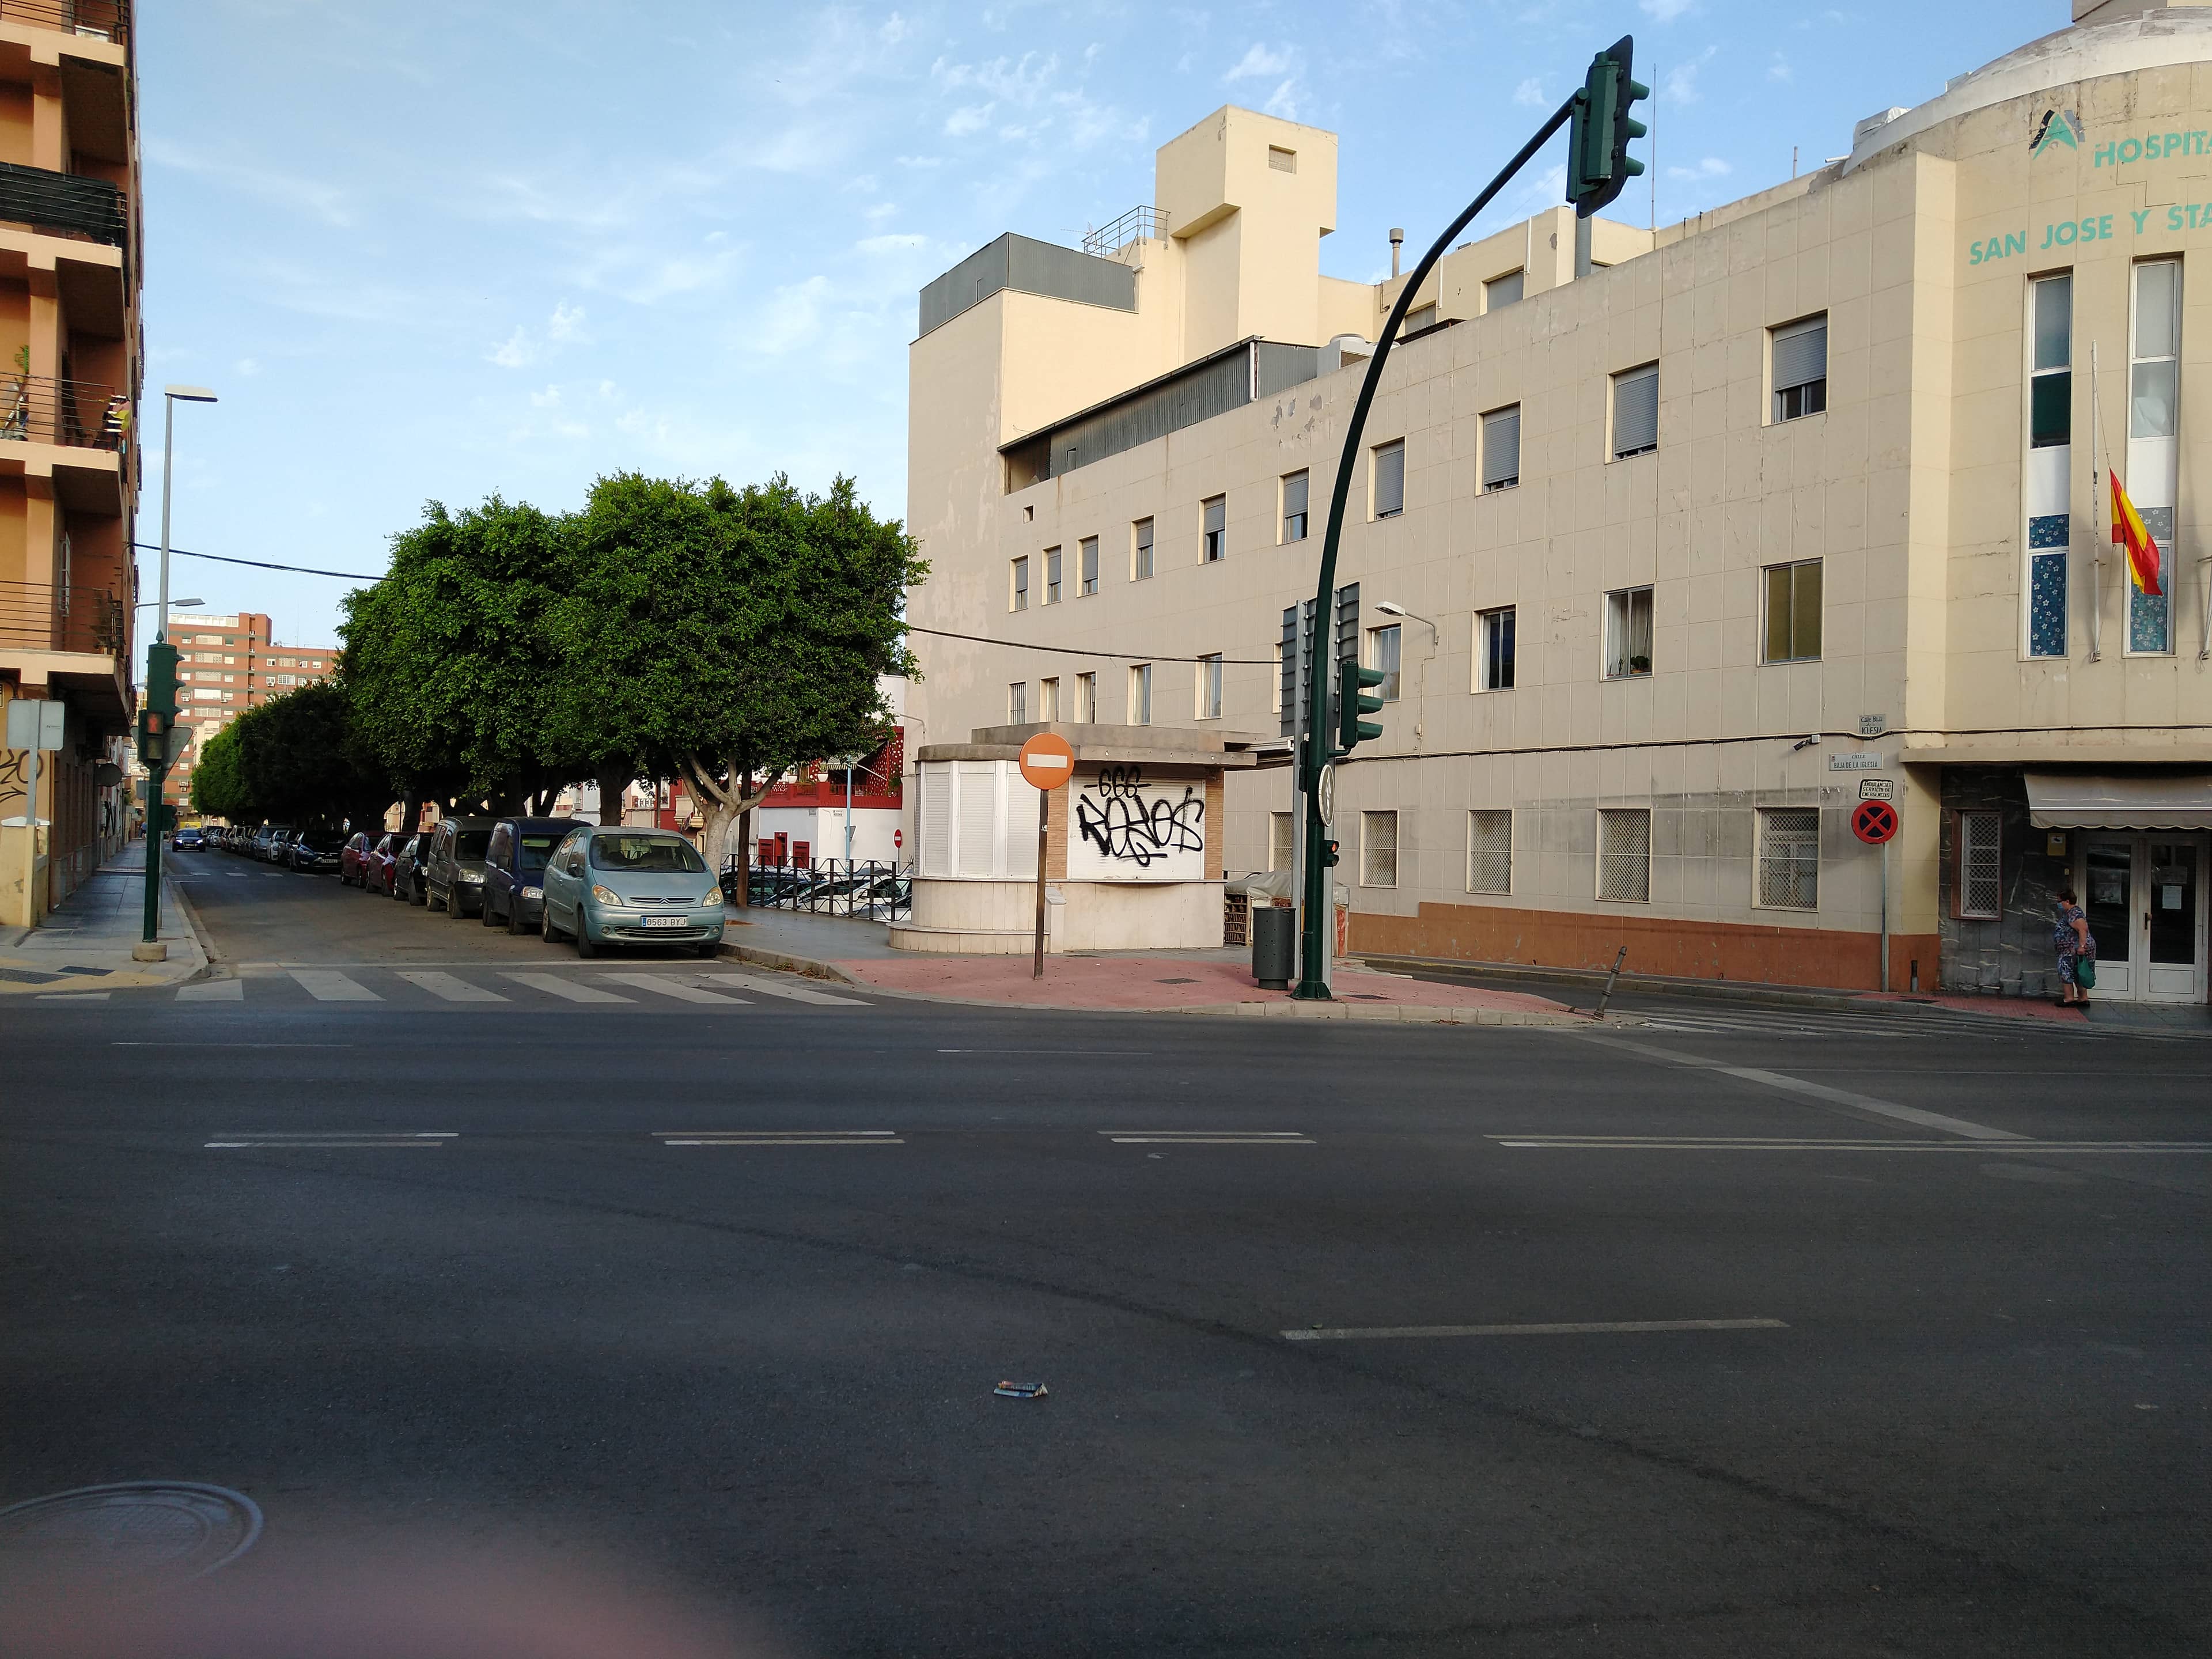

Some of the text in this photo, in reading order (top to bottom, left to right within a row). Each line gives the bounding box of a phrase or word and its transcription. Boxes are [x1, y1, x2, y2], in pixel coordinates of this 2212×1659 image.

[1969, 230, 2027, 266] SAN
[2040, 214, 2113, 249] JOSE
[2130, 209, 2151, 234] Y
[1861, 726, 1883, 734] IGLESIA
